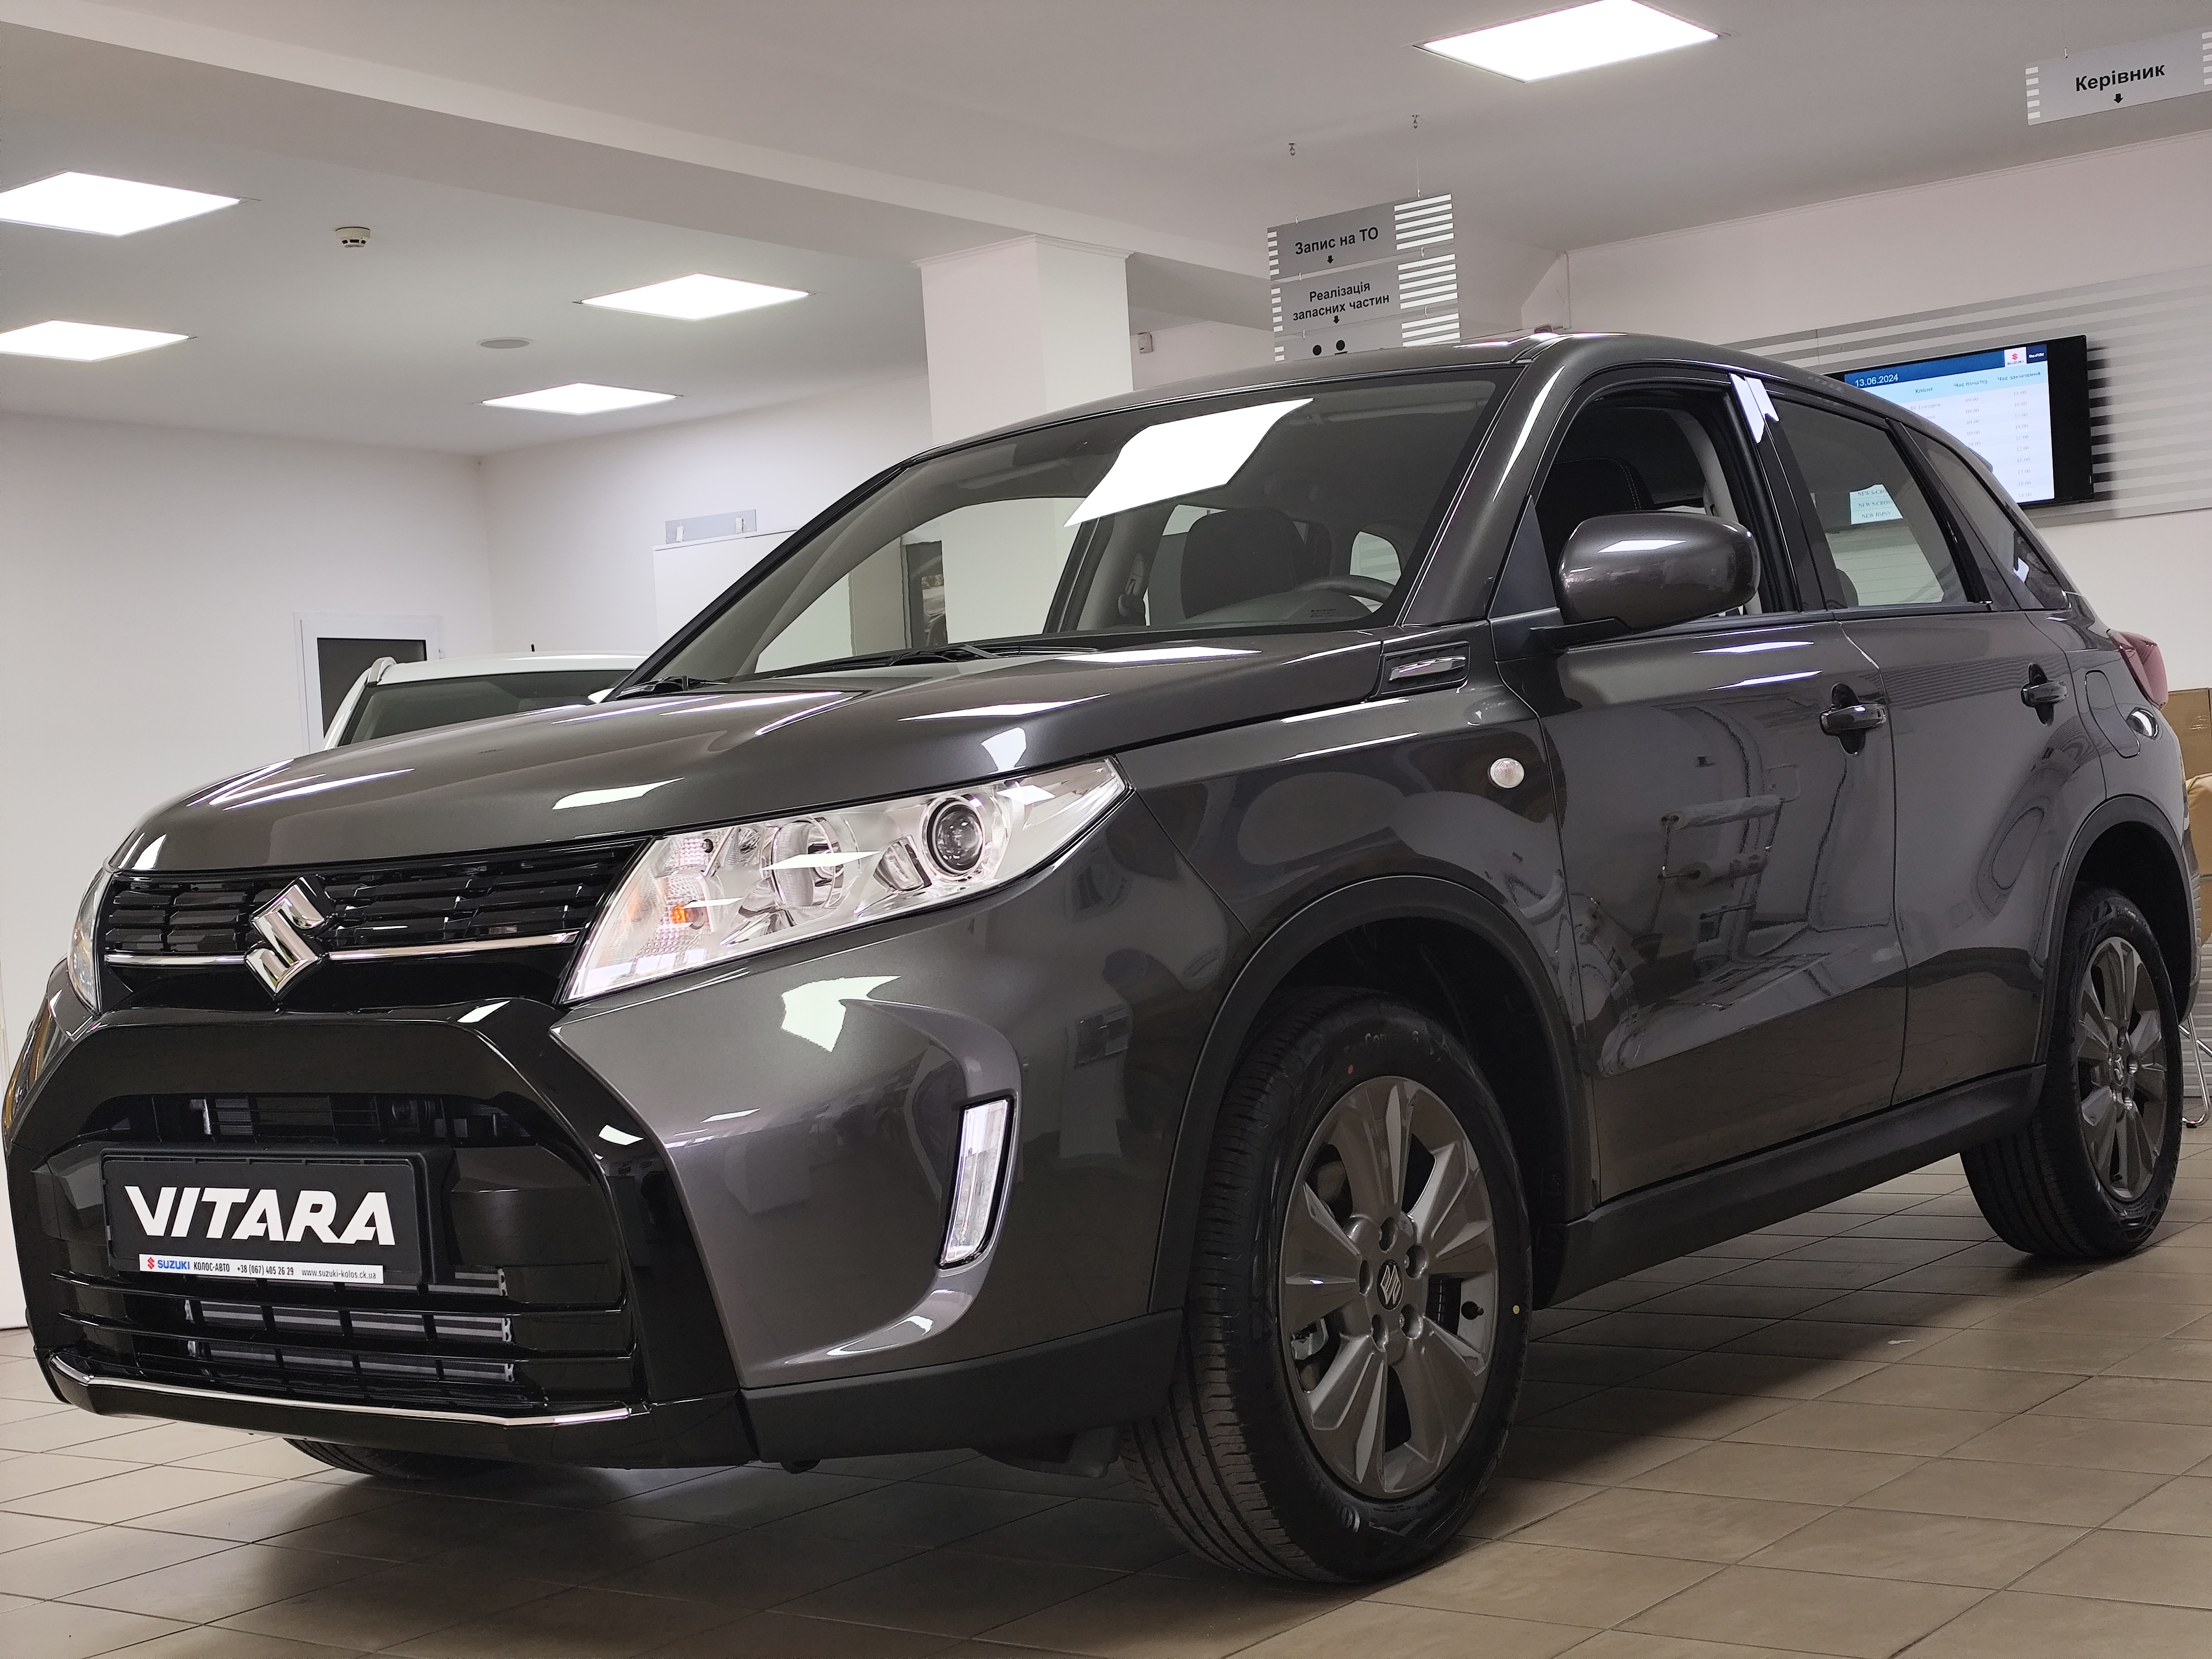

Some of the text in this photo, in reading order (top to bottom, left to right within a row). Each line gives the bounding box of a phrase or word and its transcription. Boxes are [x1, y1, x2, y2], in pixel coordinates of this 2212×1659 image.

[2075, 65, 2165, 92] Керівник
[1295, 227, 1379, 255] Запис на ТО
[1309, 281, 1371, 303] Реалізація
[1293, 294, 1390, 321] запасних частин
[1854, 373, 1899, 388] 13.06.2024
[2010, 371, 2041, 380] закінчення
[124, 1185, 396, 1245] VITARA
[157, 1259, 376, 1279] SUZUKI КОЛОС-АВТО +38 (067) 405 26 29 www.suzuki-kolos.ck.ua
